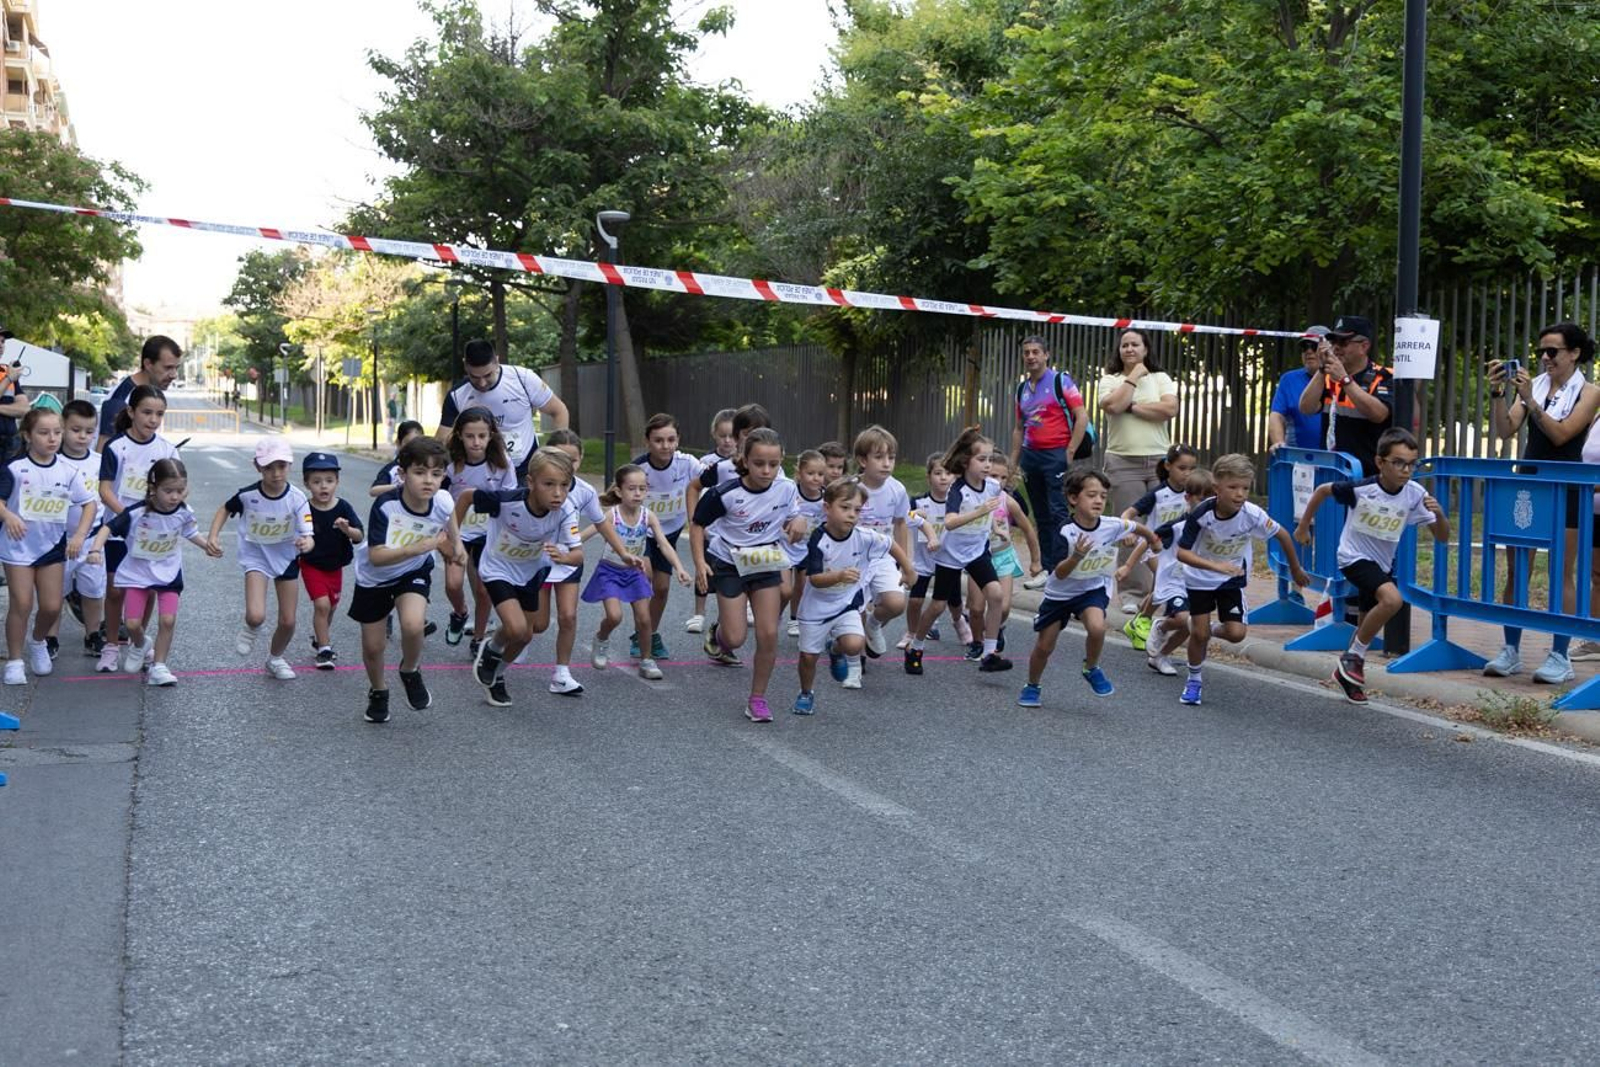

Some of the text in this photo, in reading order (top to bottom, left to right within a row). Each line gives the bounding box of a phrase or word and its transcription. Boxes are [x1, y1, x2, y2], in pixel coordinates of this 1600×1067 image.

[23, 496, 66, 514] 1009
[649, 497, 683, 513] 1011
[250, 521, 291, 537] 1021
[1360, 511, 1401, 533] 1039
[1081, 555, 1113, 572] 007
